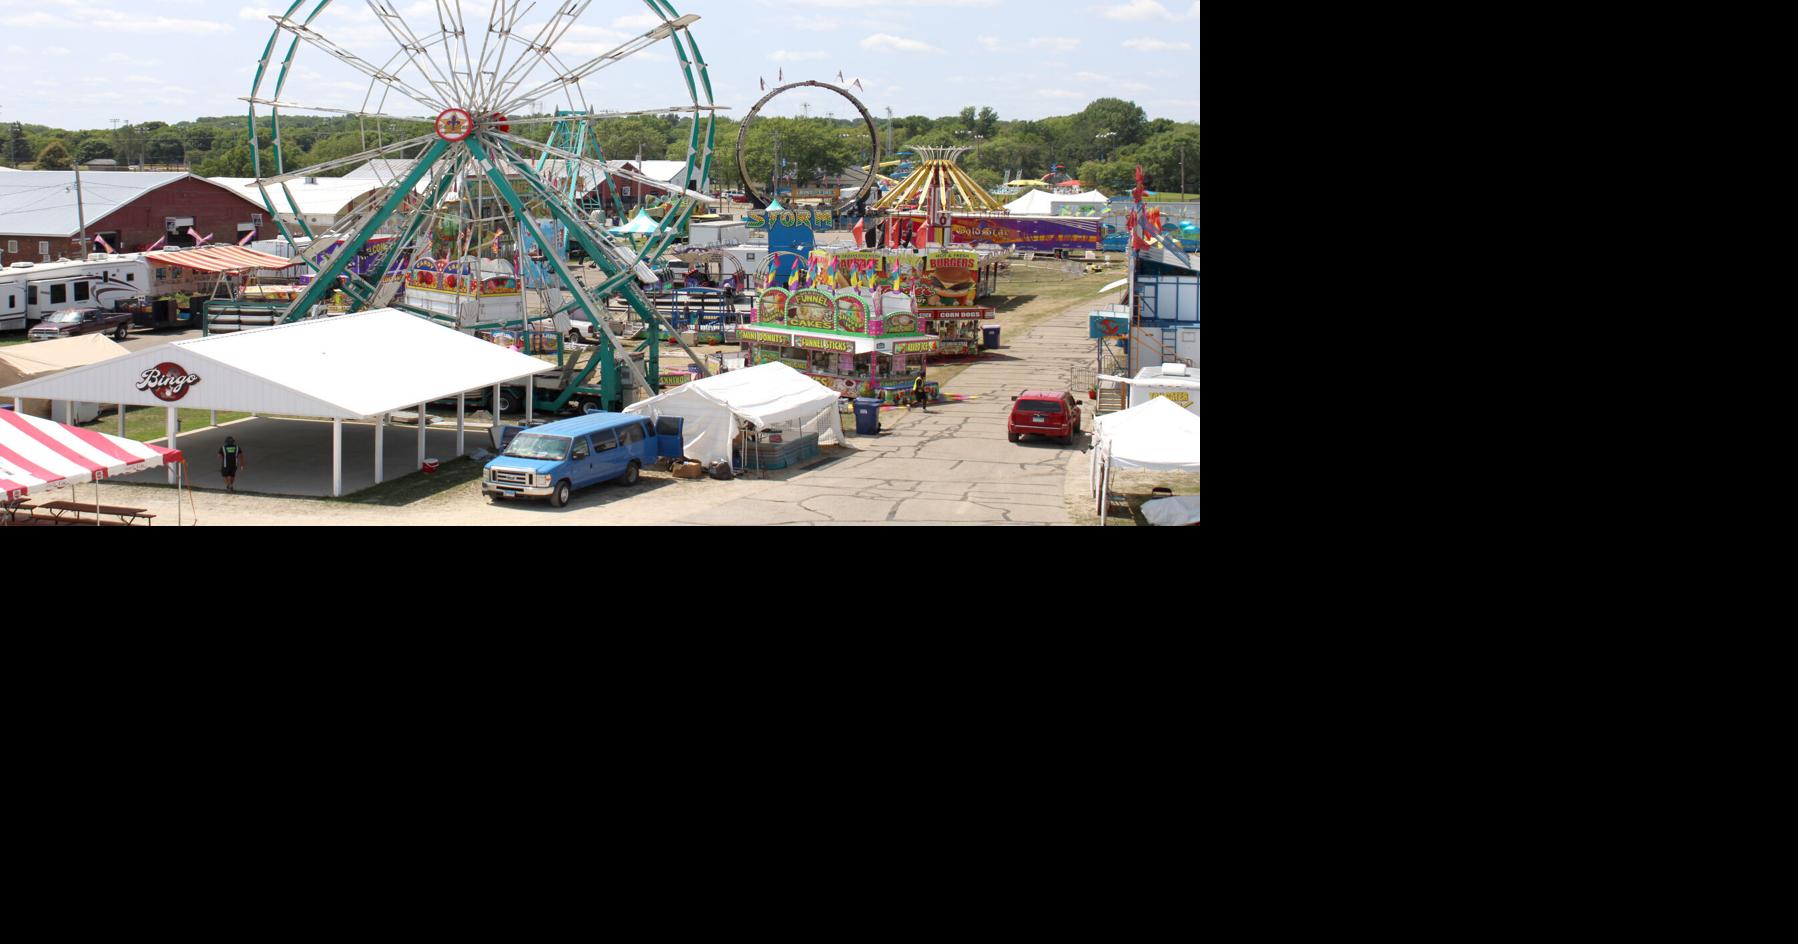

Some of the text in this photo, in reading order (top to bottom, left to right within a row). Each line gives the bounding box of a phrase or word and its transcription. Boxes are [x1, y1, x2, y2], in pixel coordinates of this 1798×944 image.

[745, 209, 833, 231] STORM
[929, 258, 975, 268] BURGERS
[796, 294, 828, 307] FUNNEL
[790, 319, 832, 329] CAKES
[741, 331, 784, 343] MINI DONUTS
[802, 337, 848, 351] FUNNEL STICKS
[136, 367, 201, 393] Bingo
